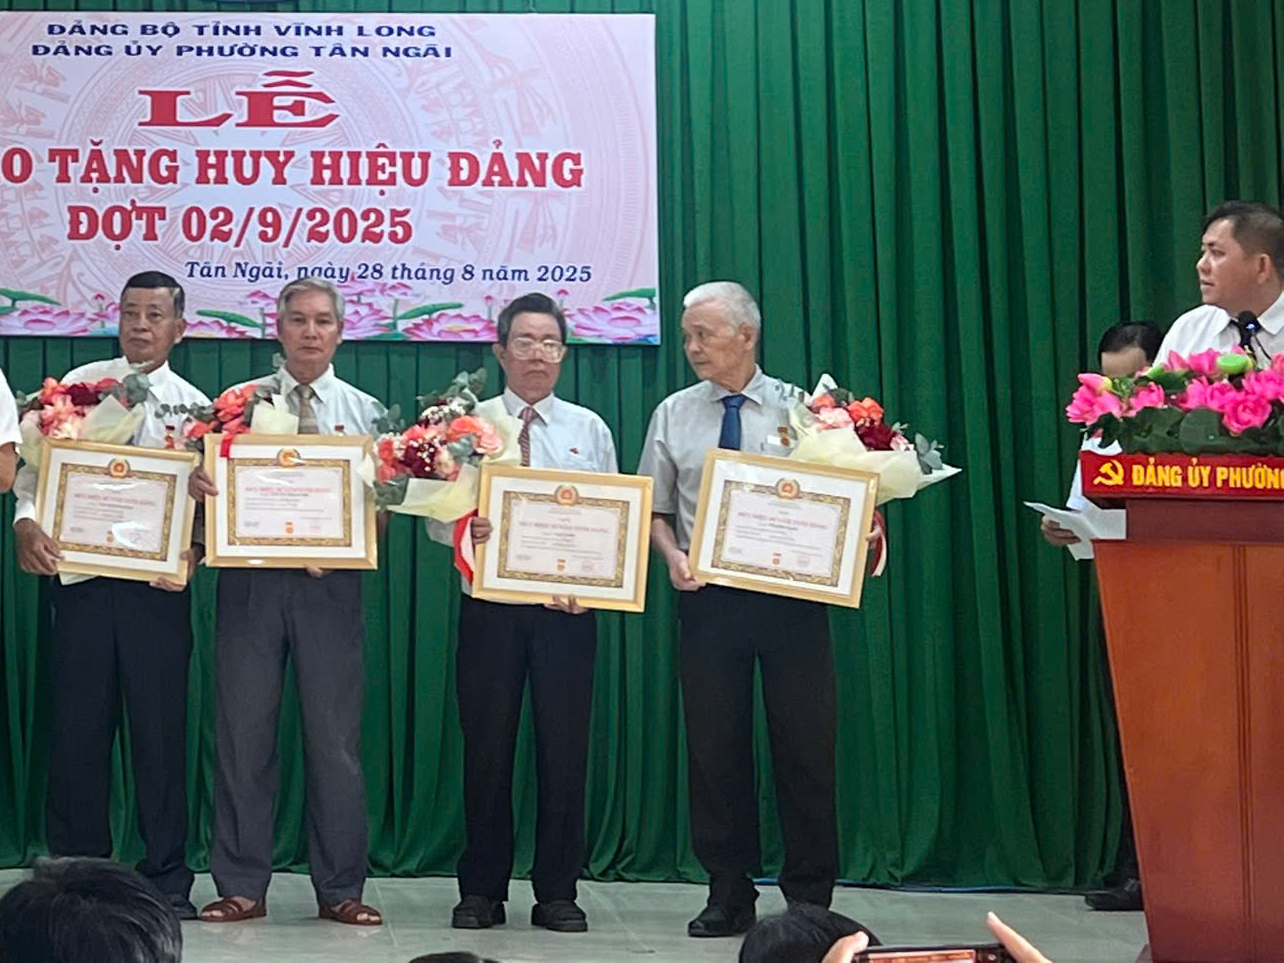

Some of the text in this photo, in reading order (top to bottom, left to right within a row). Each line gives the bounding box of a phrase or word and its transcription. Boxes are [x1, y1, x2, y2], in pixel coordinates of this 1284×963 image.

[47, 19, 437, 38] ĐẢNG BỘ TỈNH VĨNH LONG
[31, 39, 453, 58] ĐẢNG ỦY PHƯỜNG TÂN NGÃI
[137, 69, 341, 129] LỄ
[47, 138, 180, 194] TẶNG
[195, 148, 296, 186] HUY
[309, 142, 432, 197] HIỆU
[447, 139, 585, 189] ĐẢNG
[66, 198, 414, 251] ĐỢT 02/9/2025
[185, 261, 227, 279] Tân
[232, 260, 290, 283] Ngãi,
[356, 262, 384, 280] 28
[390, 262, 455, 285] tháng
[461, 263, 475, 281] 8
[481, 264, 530, 282] năm
[536, 264, 593, 283] 2025
[1131, 456, 1184, 487] ĐẢNG
[1187, 457, 1212, 488] ỦY
